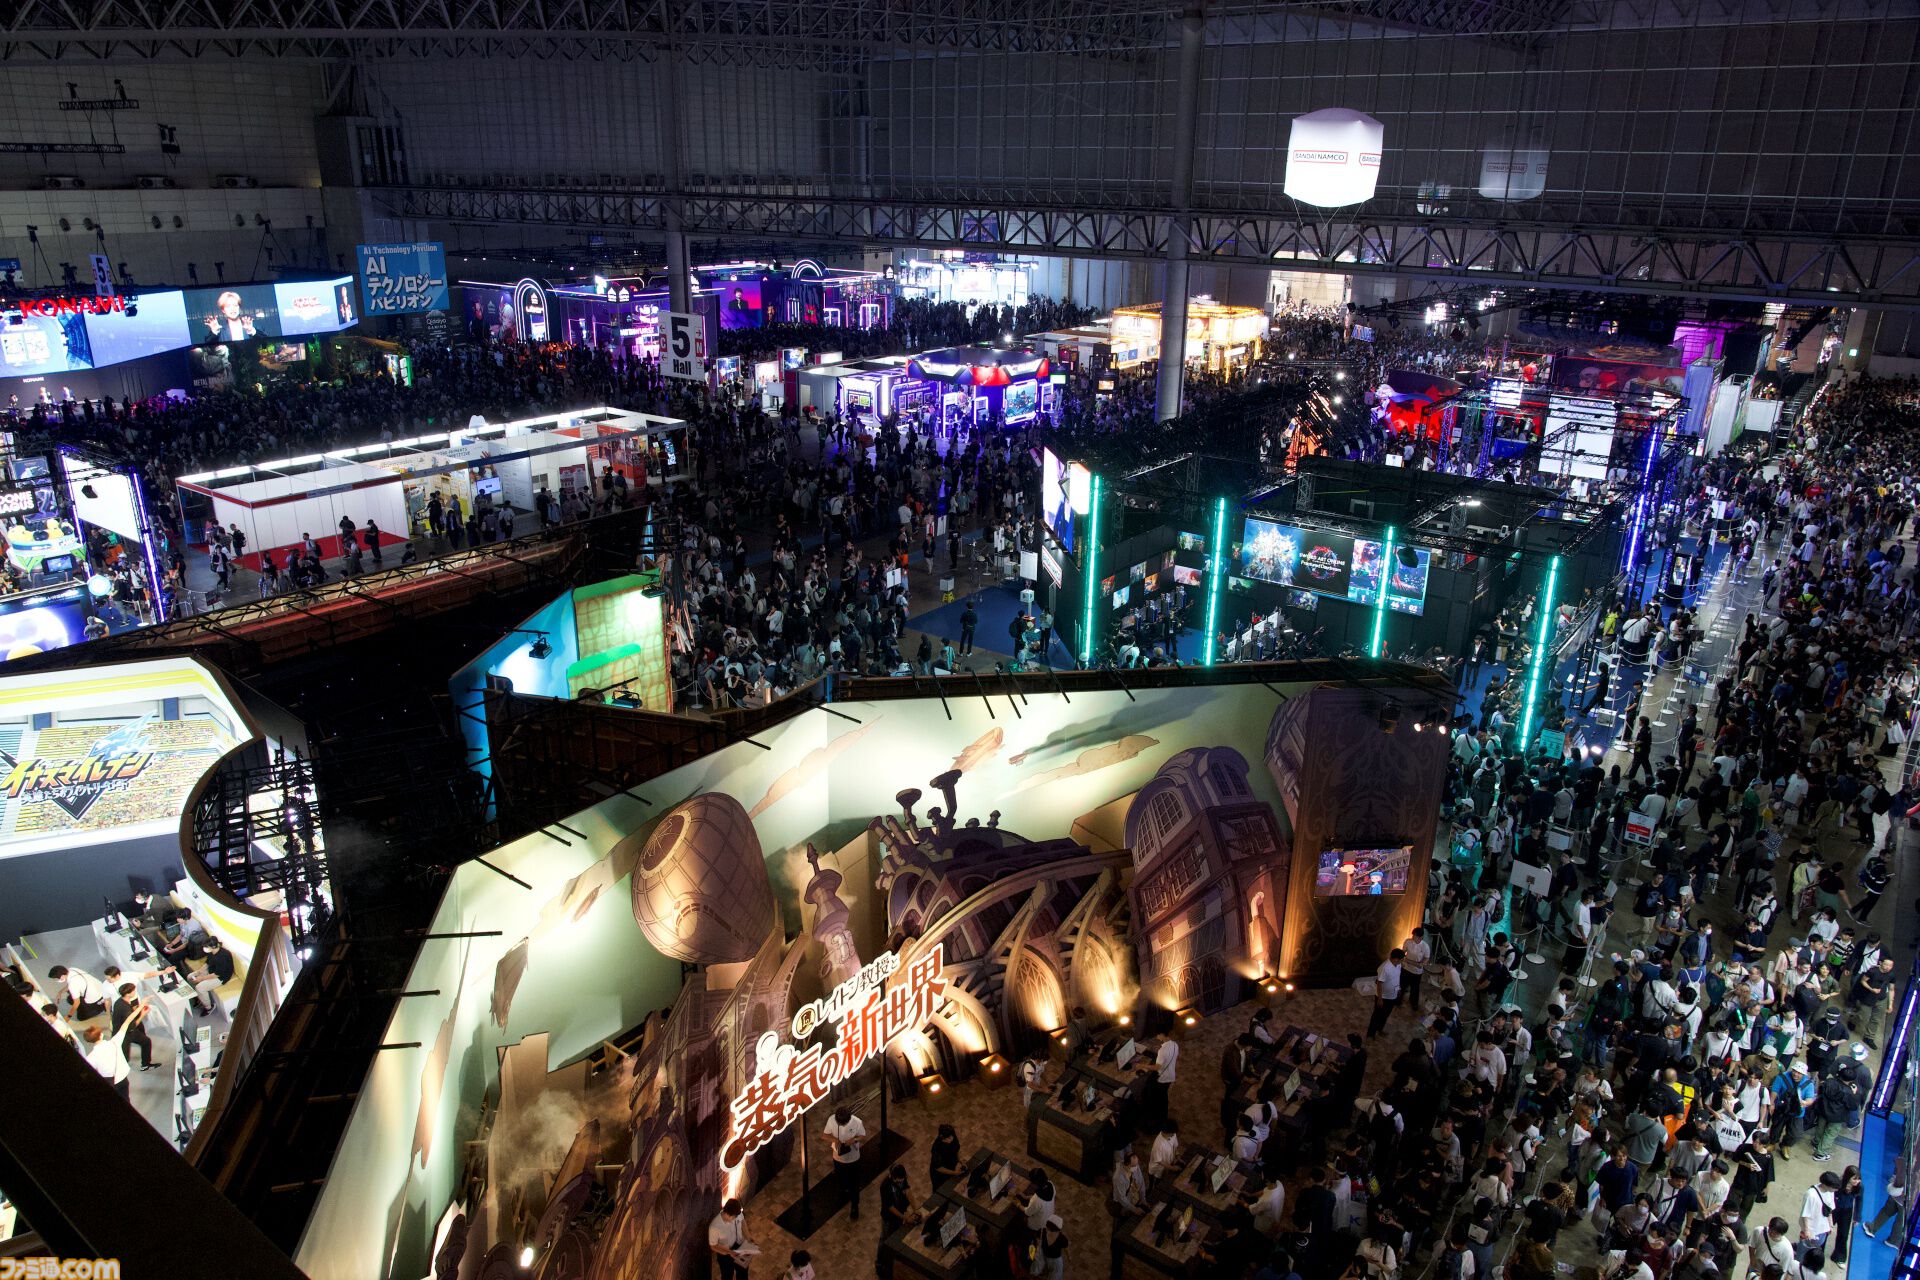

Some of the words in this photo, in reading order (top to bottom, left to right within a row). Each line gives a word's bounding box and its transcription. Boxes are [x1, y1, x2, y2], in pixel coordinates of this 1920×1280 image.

[1317, 153, 1345, 161] NAMCO
[364, 247, 371, 255] AI
[372, 246, 411, 255] Technology
[412, 244, 438, 253] Pavilion
[95, 257, 107, 284] 5
[366, 256, 387, 275] AI
[368, 273, 442, 296] テクノロジー
[19, 294, 125, 319] KONAMI
[371, 294, 432, 310] パビリオン
[660, 337, 666, 349] C
[671, 316, 691, 359] 5
[673, 358, 692, 376] Hall
[816, 954, 898, 1023] レイトン教授と
[724, 949, 946, 1168] 蒸気の新世界
